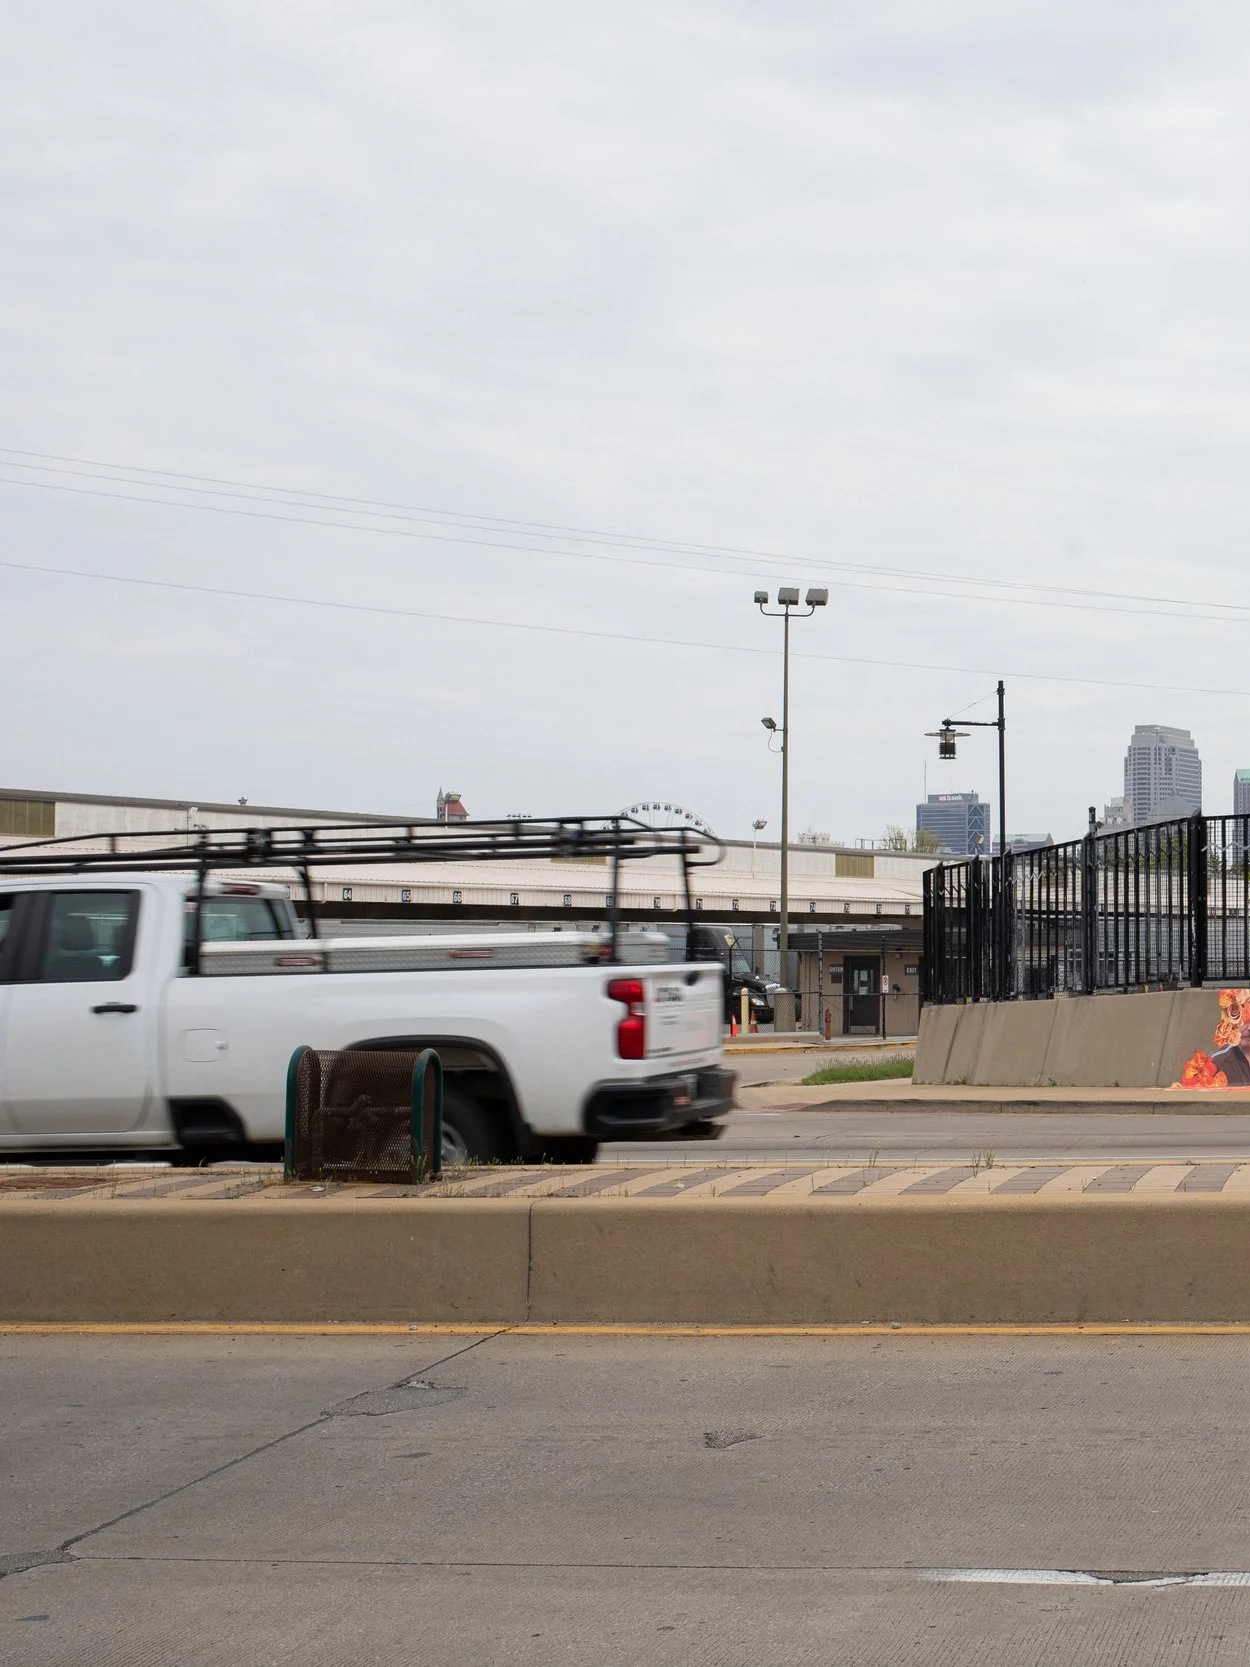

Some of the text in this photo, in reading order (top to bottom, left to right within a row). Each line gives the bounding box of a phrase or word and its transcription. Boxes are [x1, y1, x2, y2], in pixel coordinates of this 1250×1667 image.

[343, 889, 352, 900] 64
[402, 890, 411, 902] 65
[453, 892, 461, 903] 66
[511, 894, 519, 904] 67
